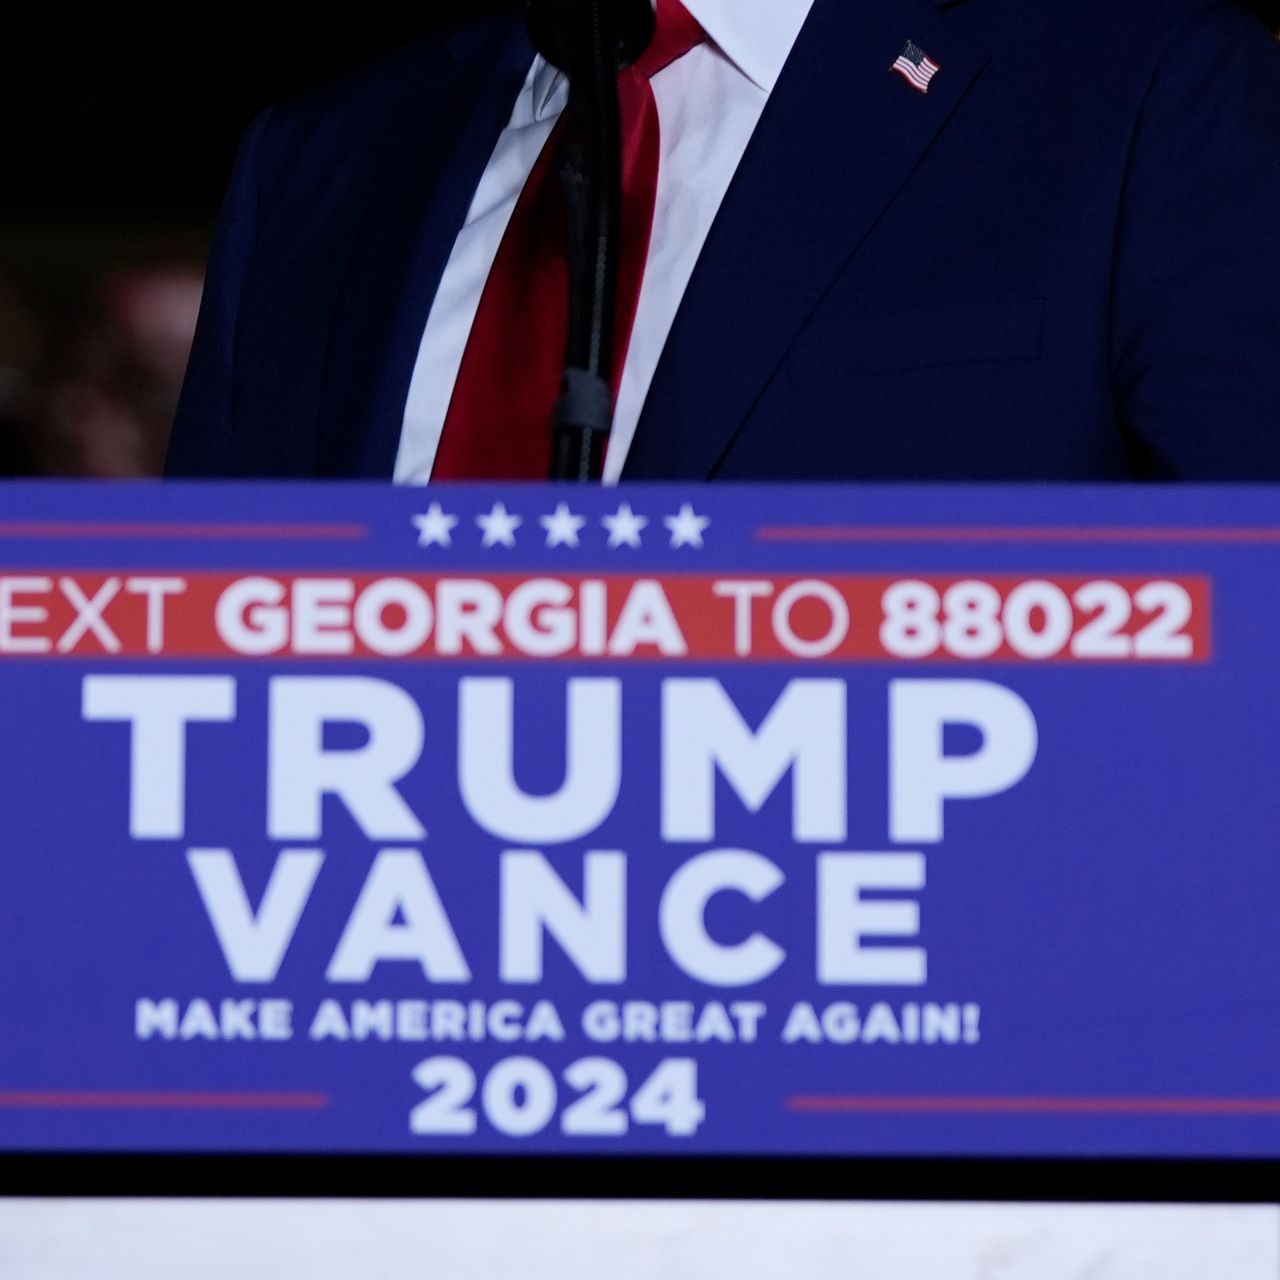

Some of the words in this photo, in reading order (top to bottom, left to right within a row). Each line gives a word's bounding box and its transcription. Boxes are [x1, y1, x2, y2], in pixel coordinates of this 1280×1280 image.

[216, 578, 686, 656] GEORGIA
[714, 580, 849, 657] TO
[880, 581, 1192, 658] 88022
[82, 675, 1037, 843] TRUMP
[188, 849, 927, 986] VANCE
[136, 1000, 291, 1039] MAKE
[311, 1000, 564, 1040] AMERICA
[583, 1001, 765, 1041] GREAT
[784, 1003, 979, 1042] AGAIN!
[410, 1056, 705, 1135] 2024
